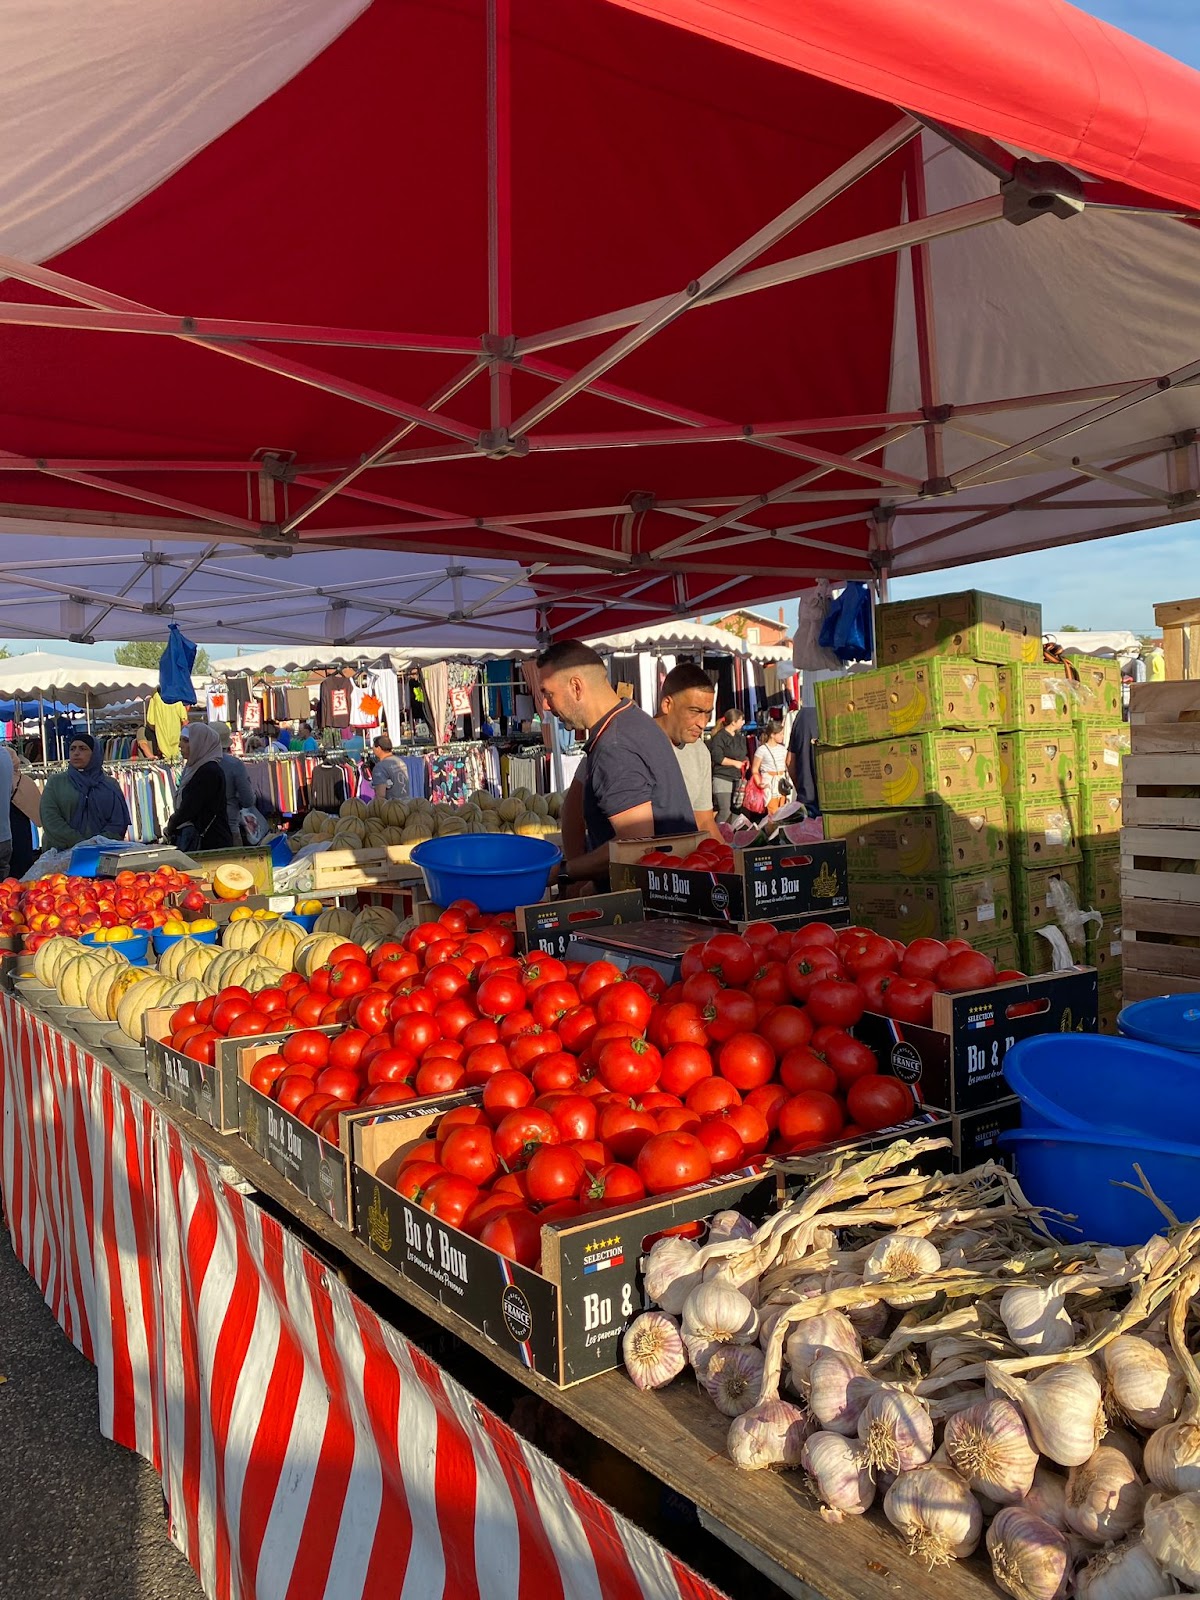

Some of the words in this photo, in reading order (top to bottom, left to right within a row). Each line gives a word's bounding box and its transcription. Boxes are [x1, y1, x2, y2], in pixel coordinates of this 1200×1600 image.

[663, 872, 669, 892] &
[771, 879, 777, 896] &
[558, 936, 566, 954] &
[967, 1012, 994, 1023] SELECTION
[893, 1055, 920, 1071] FRANCE
[967, 1045, 986, 1074] Bo
[991, 1040, 999, 1067] &
[403, 1206, 421, 1252] Bo
[425, 1222, 435, 1261] &
[583, 1246, 624, 1266] SELECTION
[504, 1301, 530, 1326] FRANCE
[583, 1293, 612, 1332] Bo
[621, 1283, 633, 1317] &
[585, 1333, 597, 1348] Les
